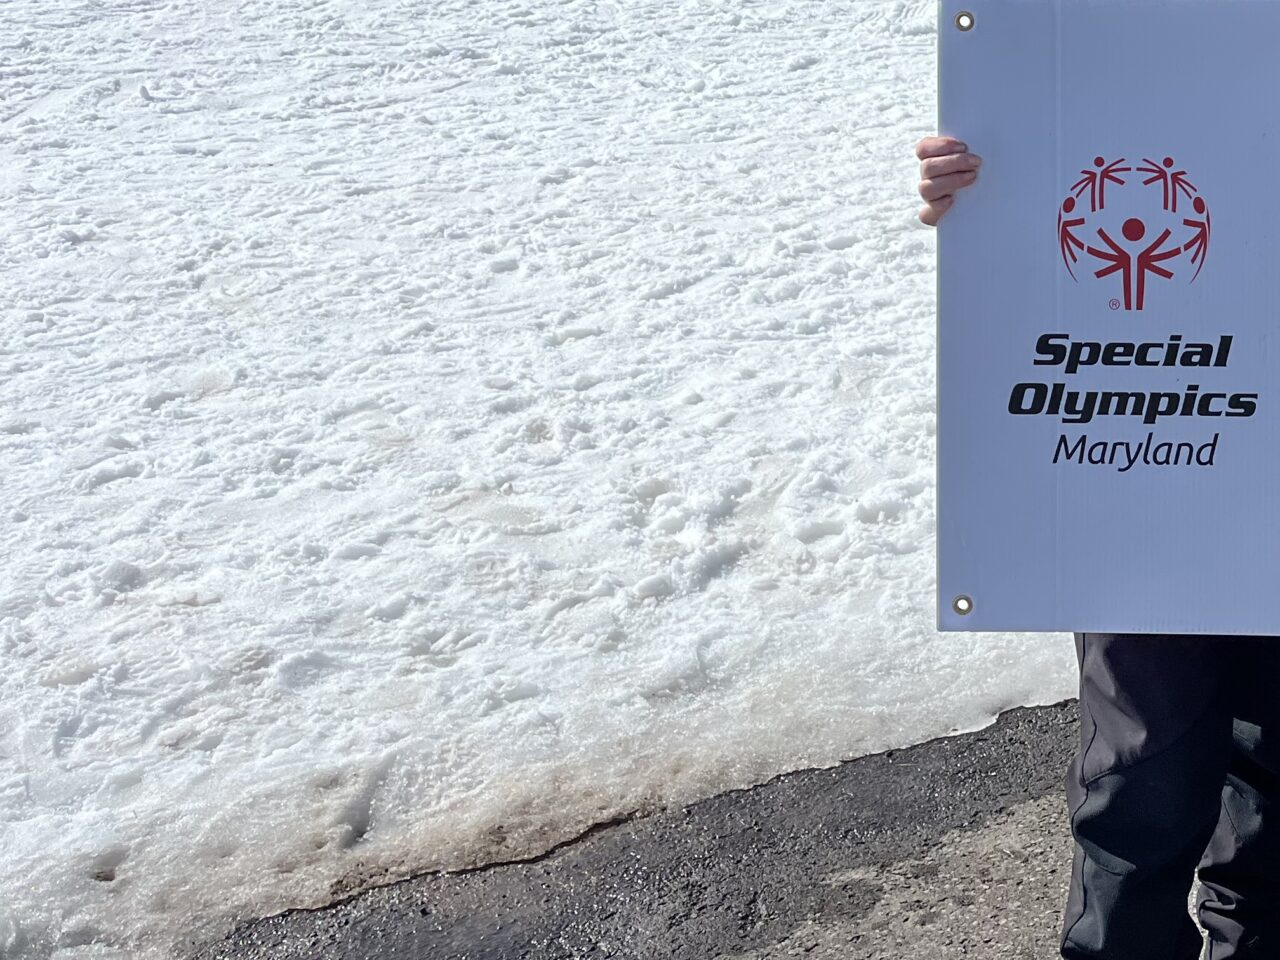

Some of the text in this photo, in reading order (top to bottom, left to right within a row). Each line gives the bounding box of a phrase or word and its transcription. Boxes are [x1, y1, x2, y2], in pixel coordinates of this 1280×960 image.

[1033, 334, 1234, 374] Special
[1007, 383, 1259, 424] Olympics
[1052, 432, 1220, 473] Maryland
